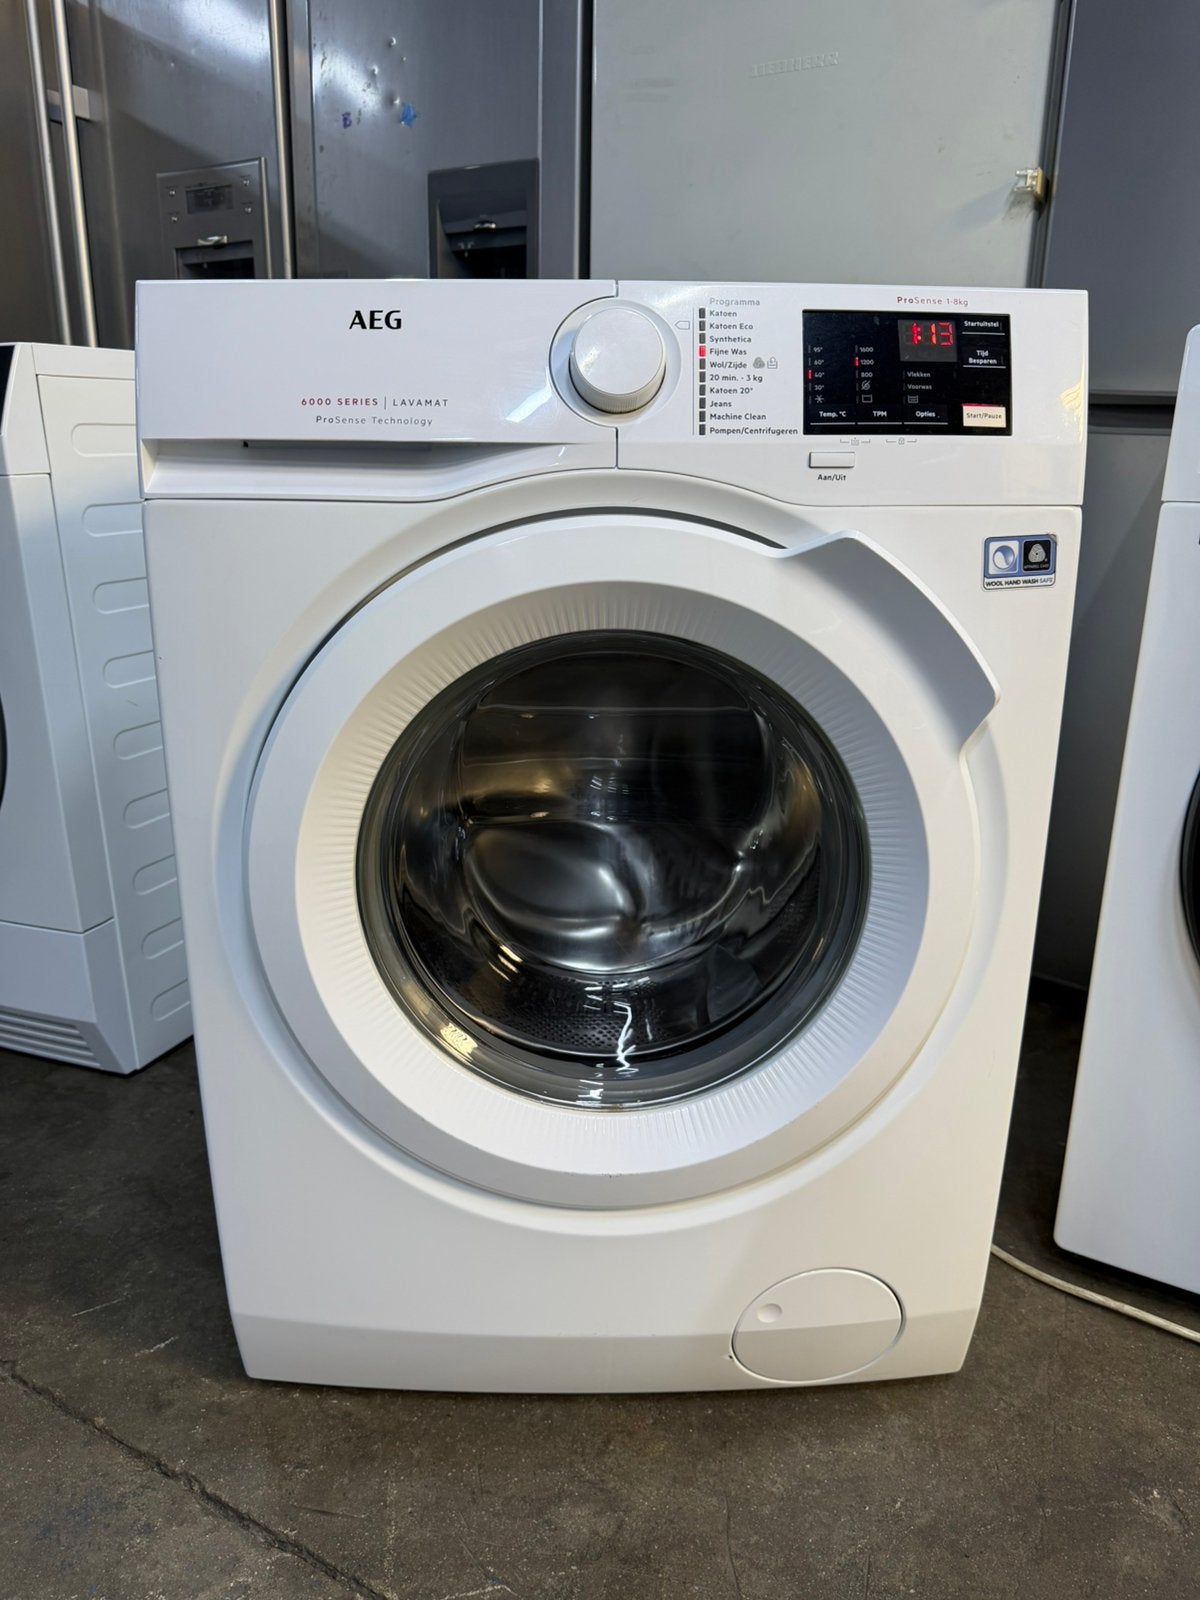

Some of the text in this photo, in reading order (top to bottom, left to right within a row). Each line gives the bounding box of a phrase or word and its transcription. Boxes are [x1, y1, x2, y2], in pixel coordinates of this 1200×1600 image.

[709, 298, 760, 306] Programma
[897, 297, 942, 305] ProSense
[349, 310, 402, 330] AEG
[964, 320, 999, 328] Startuitstel
[910, 322, 953, 346] 1:13
[710, 348, 729, 356] Fijne
[710, 361, 747, 369] Wol/Zijde
[968, 357, 997, 365] Besparen
[753, 375, 763, 383] kg
[301, 398, 448, 407] 6000 SERIES LAVAMAT
[316, 416, 433, 427] ProSense Technology
[710, 427, 798, 435] Pompen/Centrifugeren
[817, 474, 846, 482] Aan/Uit
